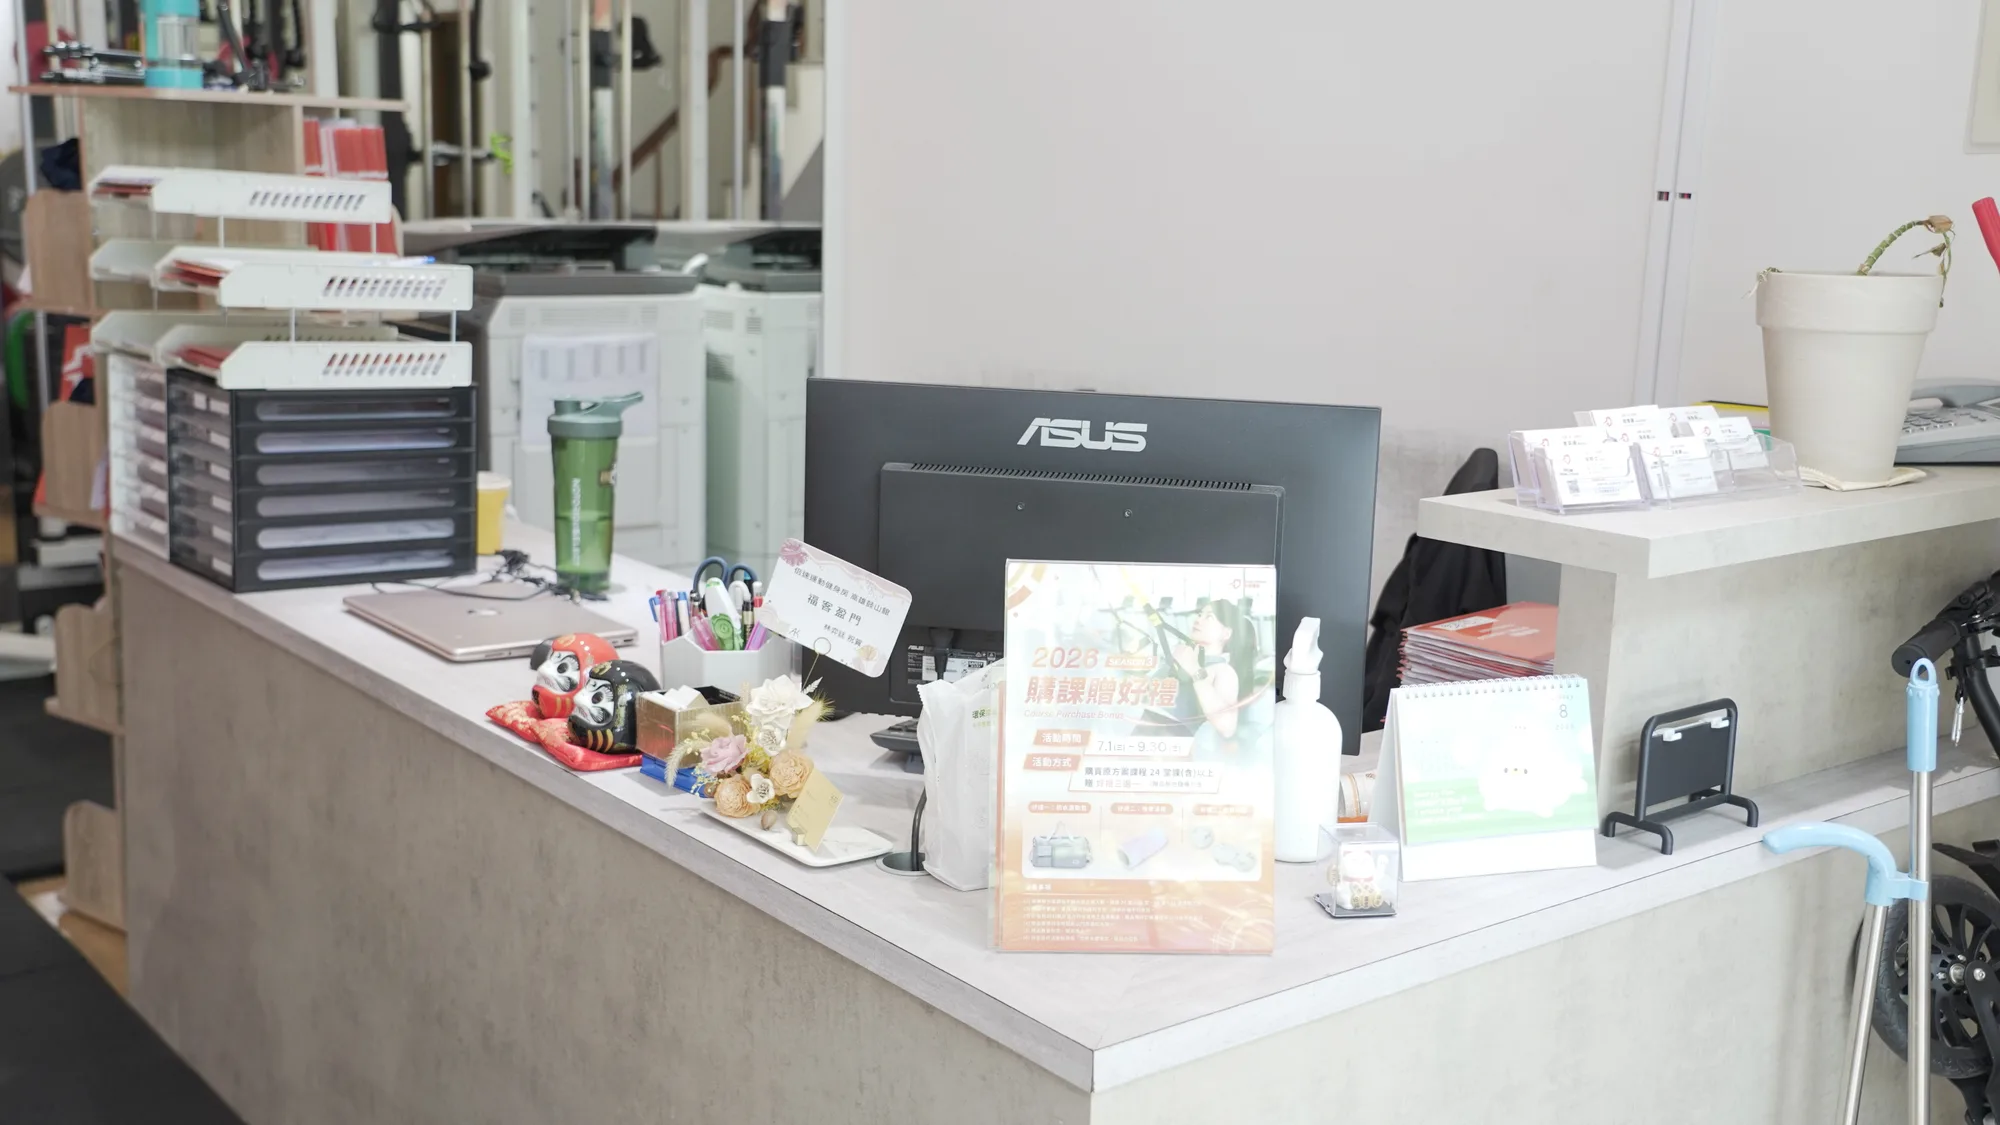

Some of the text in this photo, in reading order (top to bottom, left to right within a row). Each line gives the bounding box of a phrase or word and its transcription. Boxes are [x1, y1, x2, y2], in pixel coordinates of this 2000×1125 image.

[1017, 417, 1148, 452] ASUS
[1031, 646, 1100, 670] 2026
[1024, 676, 1180, 707] 購課贈好禮
[1056, 710, 1096, 719] Purchase
[1559, 703, 1569, 719] 8
[1149, 768, 1160, 777] 24
